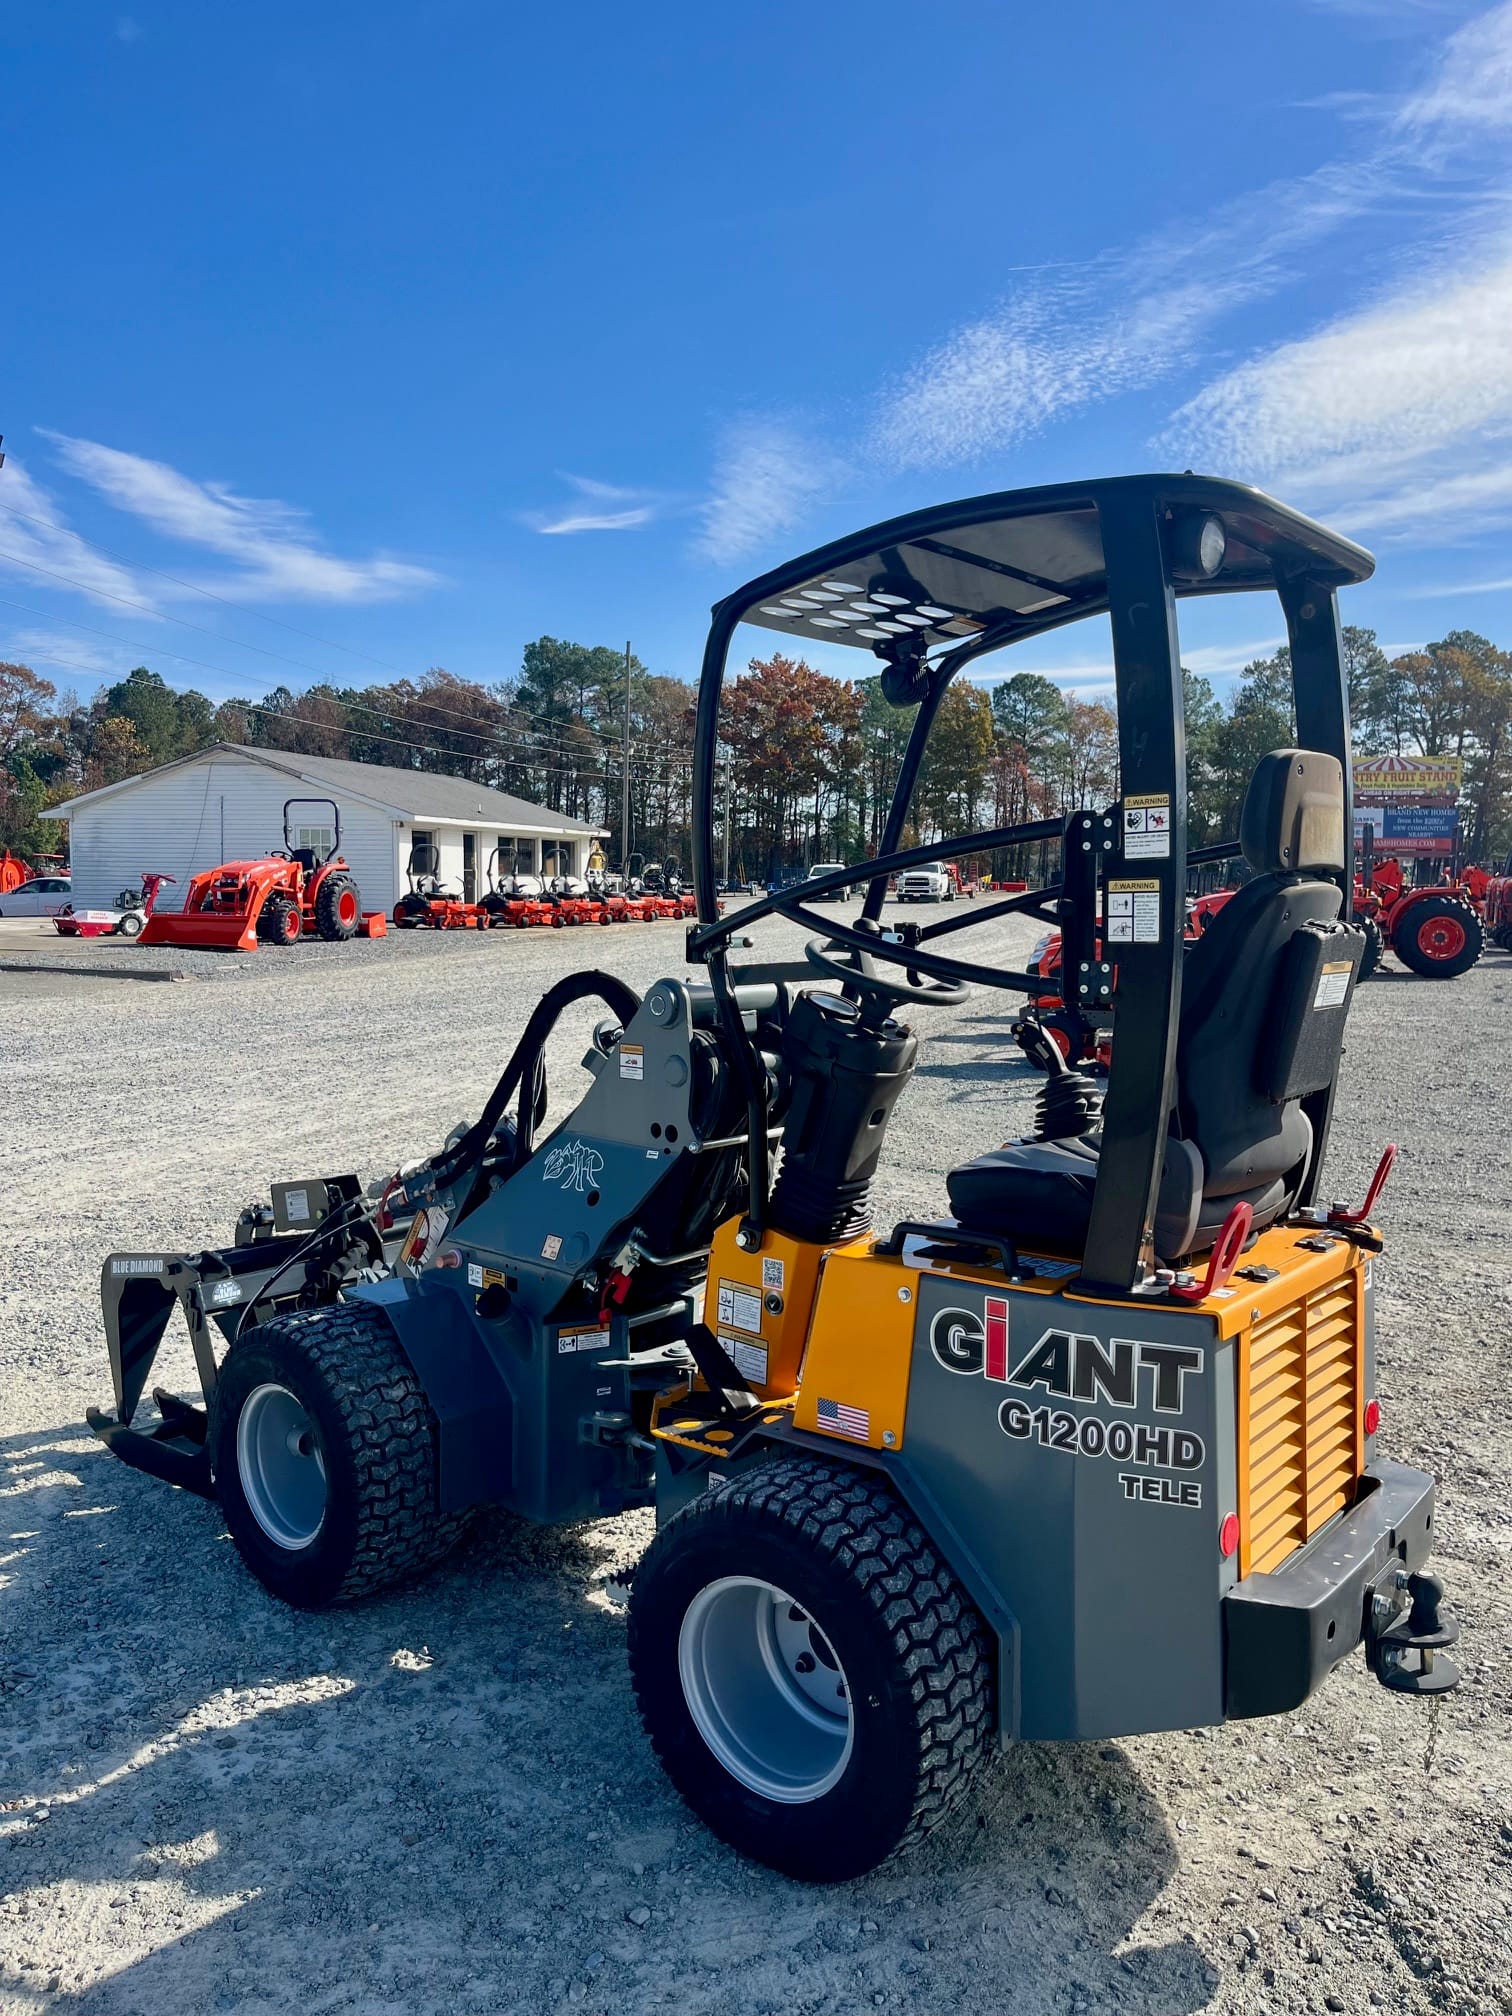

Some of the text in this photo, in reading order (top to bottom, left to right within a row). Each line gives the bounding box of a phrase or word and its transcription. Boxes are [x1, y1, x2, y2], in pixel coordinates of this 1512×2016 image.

[1353, 772, 1457, 782] NTRY FRUIT STAND
[1132, 796, 1168, 806] WARNING
[112, 1260, 164, 1274] BLUE DIAMOND
[997, 1398, 1206, 1471] G1200HD
[1118, 1473, 1202, 1508] TELE
